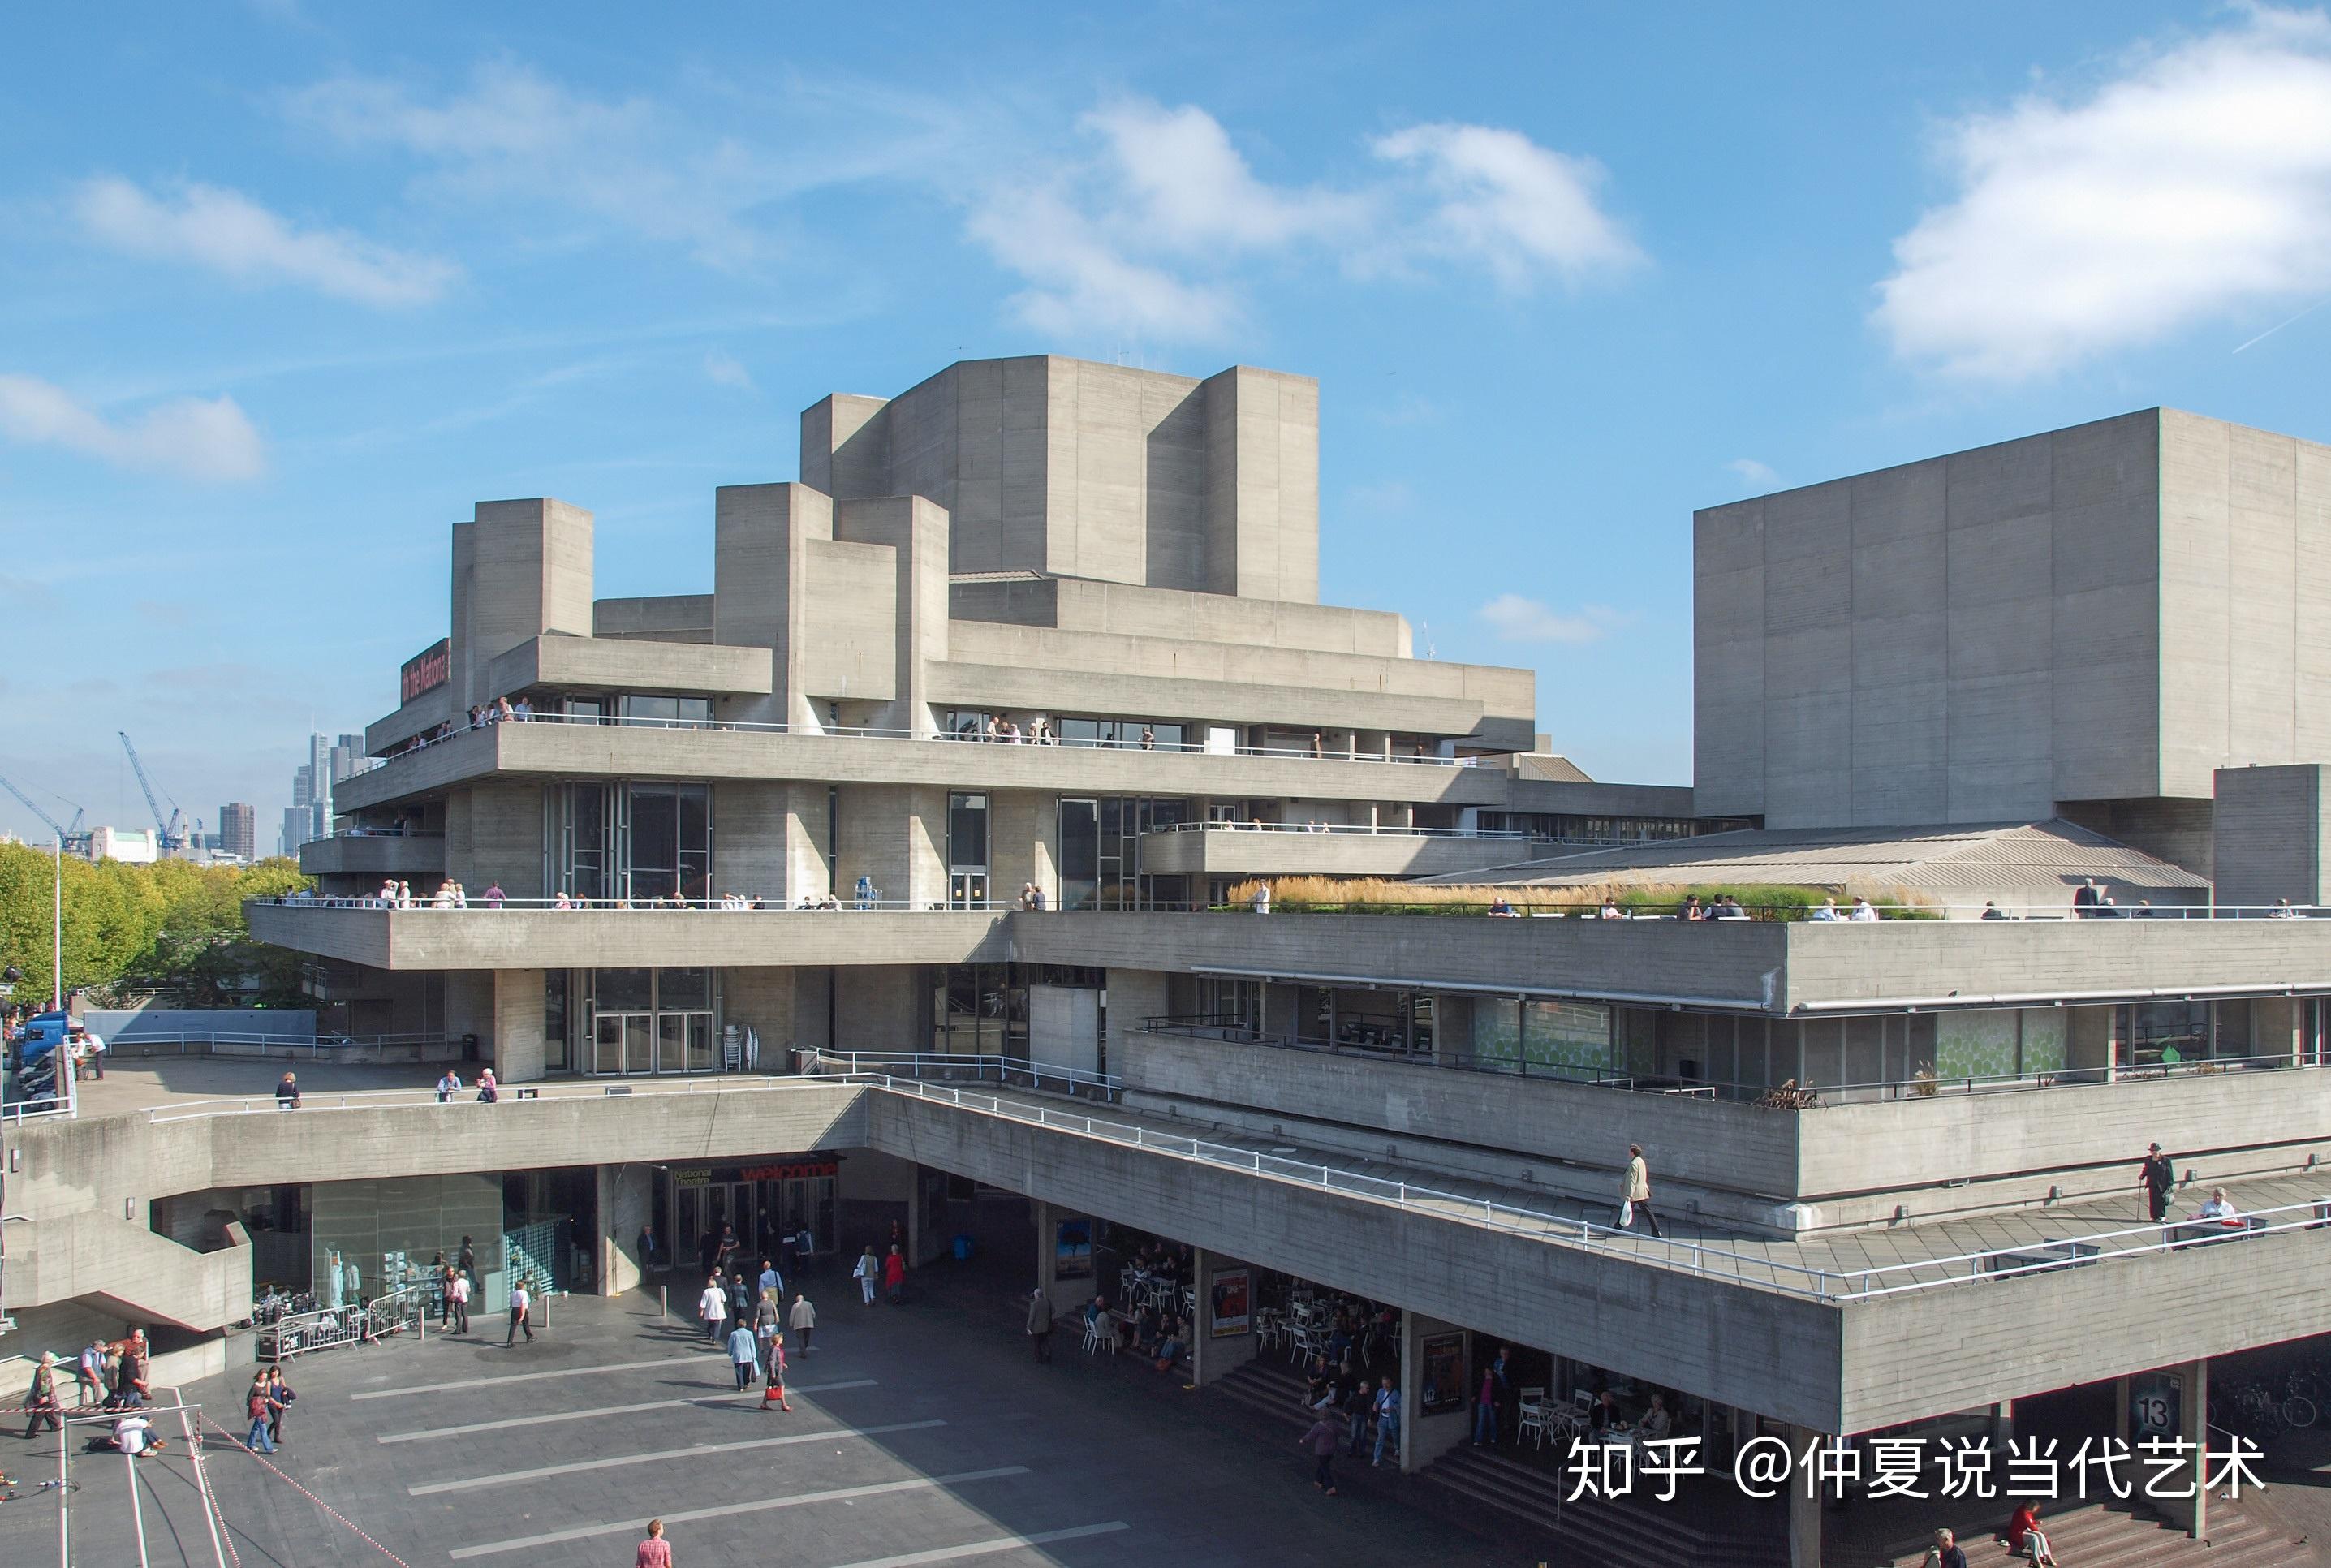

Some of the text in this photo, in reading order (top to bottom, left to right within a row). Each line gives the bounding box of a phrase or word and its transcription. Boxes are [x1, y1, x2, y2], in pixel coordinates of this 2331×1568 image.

[674, 1169, 712, 1179] National
[740, 1162, 837, 1181] welcome
[674, 1178, 710, 1187] Theatre
[2139, 1398, 2169, 1428] 13
